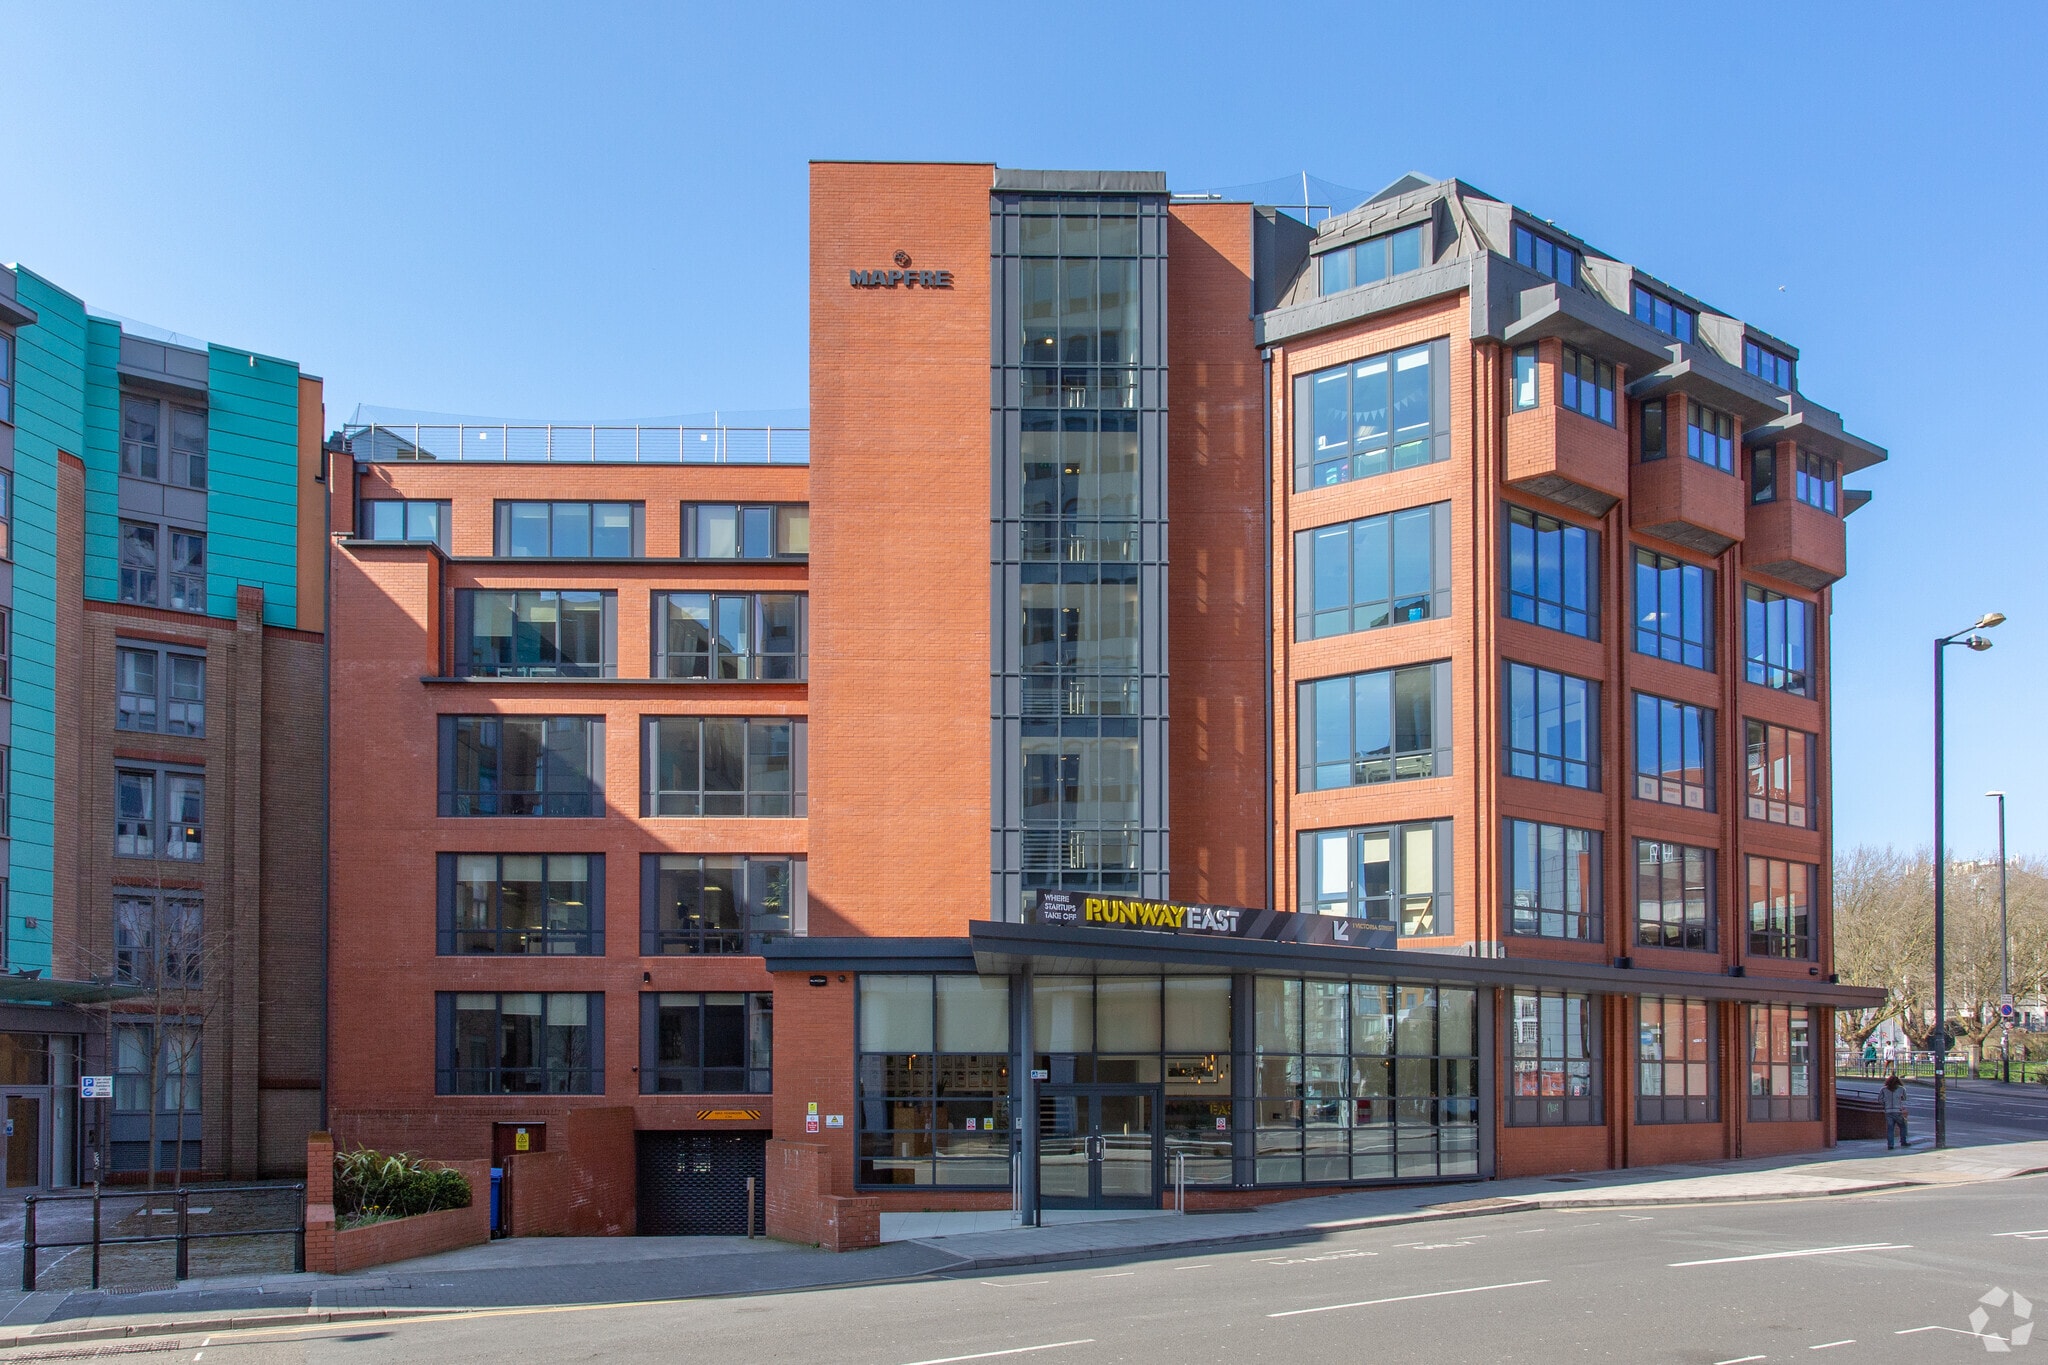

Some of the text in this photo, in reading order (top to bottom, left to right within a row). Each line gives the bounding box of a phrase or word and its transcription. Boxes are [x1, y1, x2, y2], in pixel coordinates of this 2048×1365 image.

[849, 269, 951, 287] MAPFRE
[1044, 894, 1070, 903] WHERE
[1044, 902, 1077, 912] STARTUPS
[1044, 911, 1077, 921] TAKE OFF
[1086, 898, 1240, 932] RUNWAY EAST
